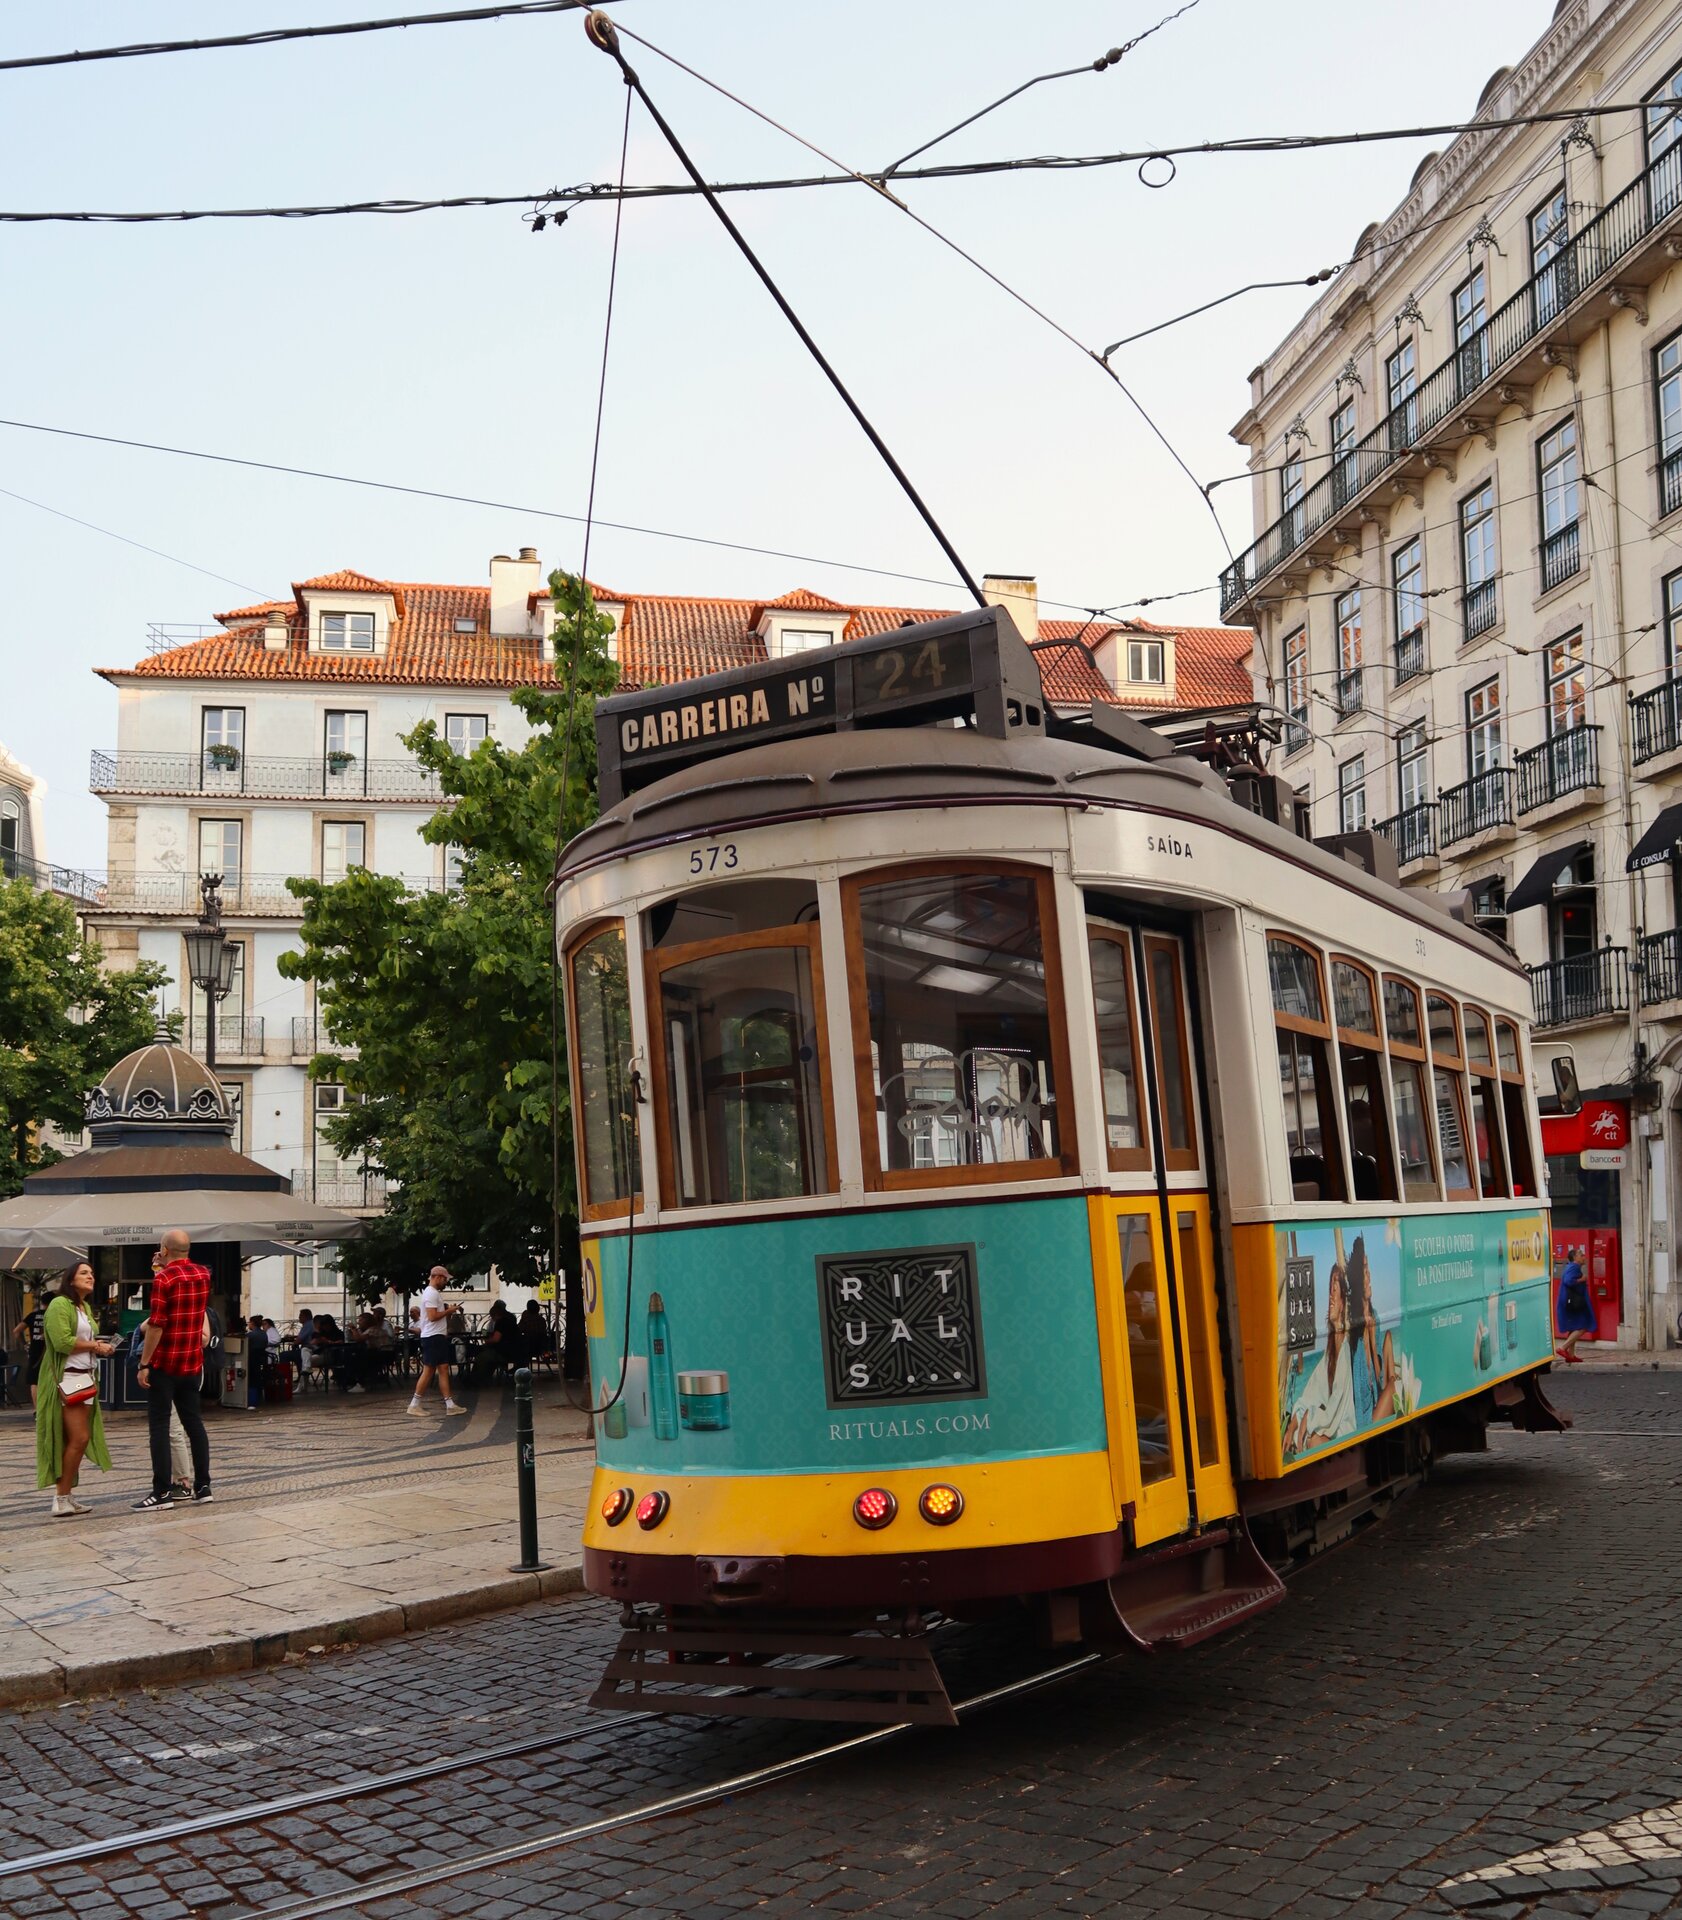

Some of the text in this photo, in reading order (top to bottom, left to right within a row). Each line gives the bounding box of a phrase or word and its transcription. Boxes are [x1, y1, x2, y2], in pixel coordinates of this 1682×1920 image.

[621, 640, 947, 752] CARREIRA Nº 24
[690, 844, 738, 874] 573
[1147, 834, 1193, 859] SAÍDA
[1632, 848, 1670, 869] LE CONSULAT
[1415, 938, 1426, 956] 573
[1604, 1131, 1617, 1140] ctt
[1414, 1233, 1474, 1258] ESCOLHA O PODER
[1417, 1259, 1473, 1286] DA POSITIVIDADE
[829, 1413, 991, 1441] RITUALS.COM
